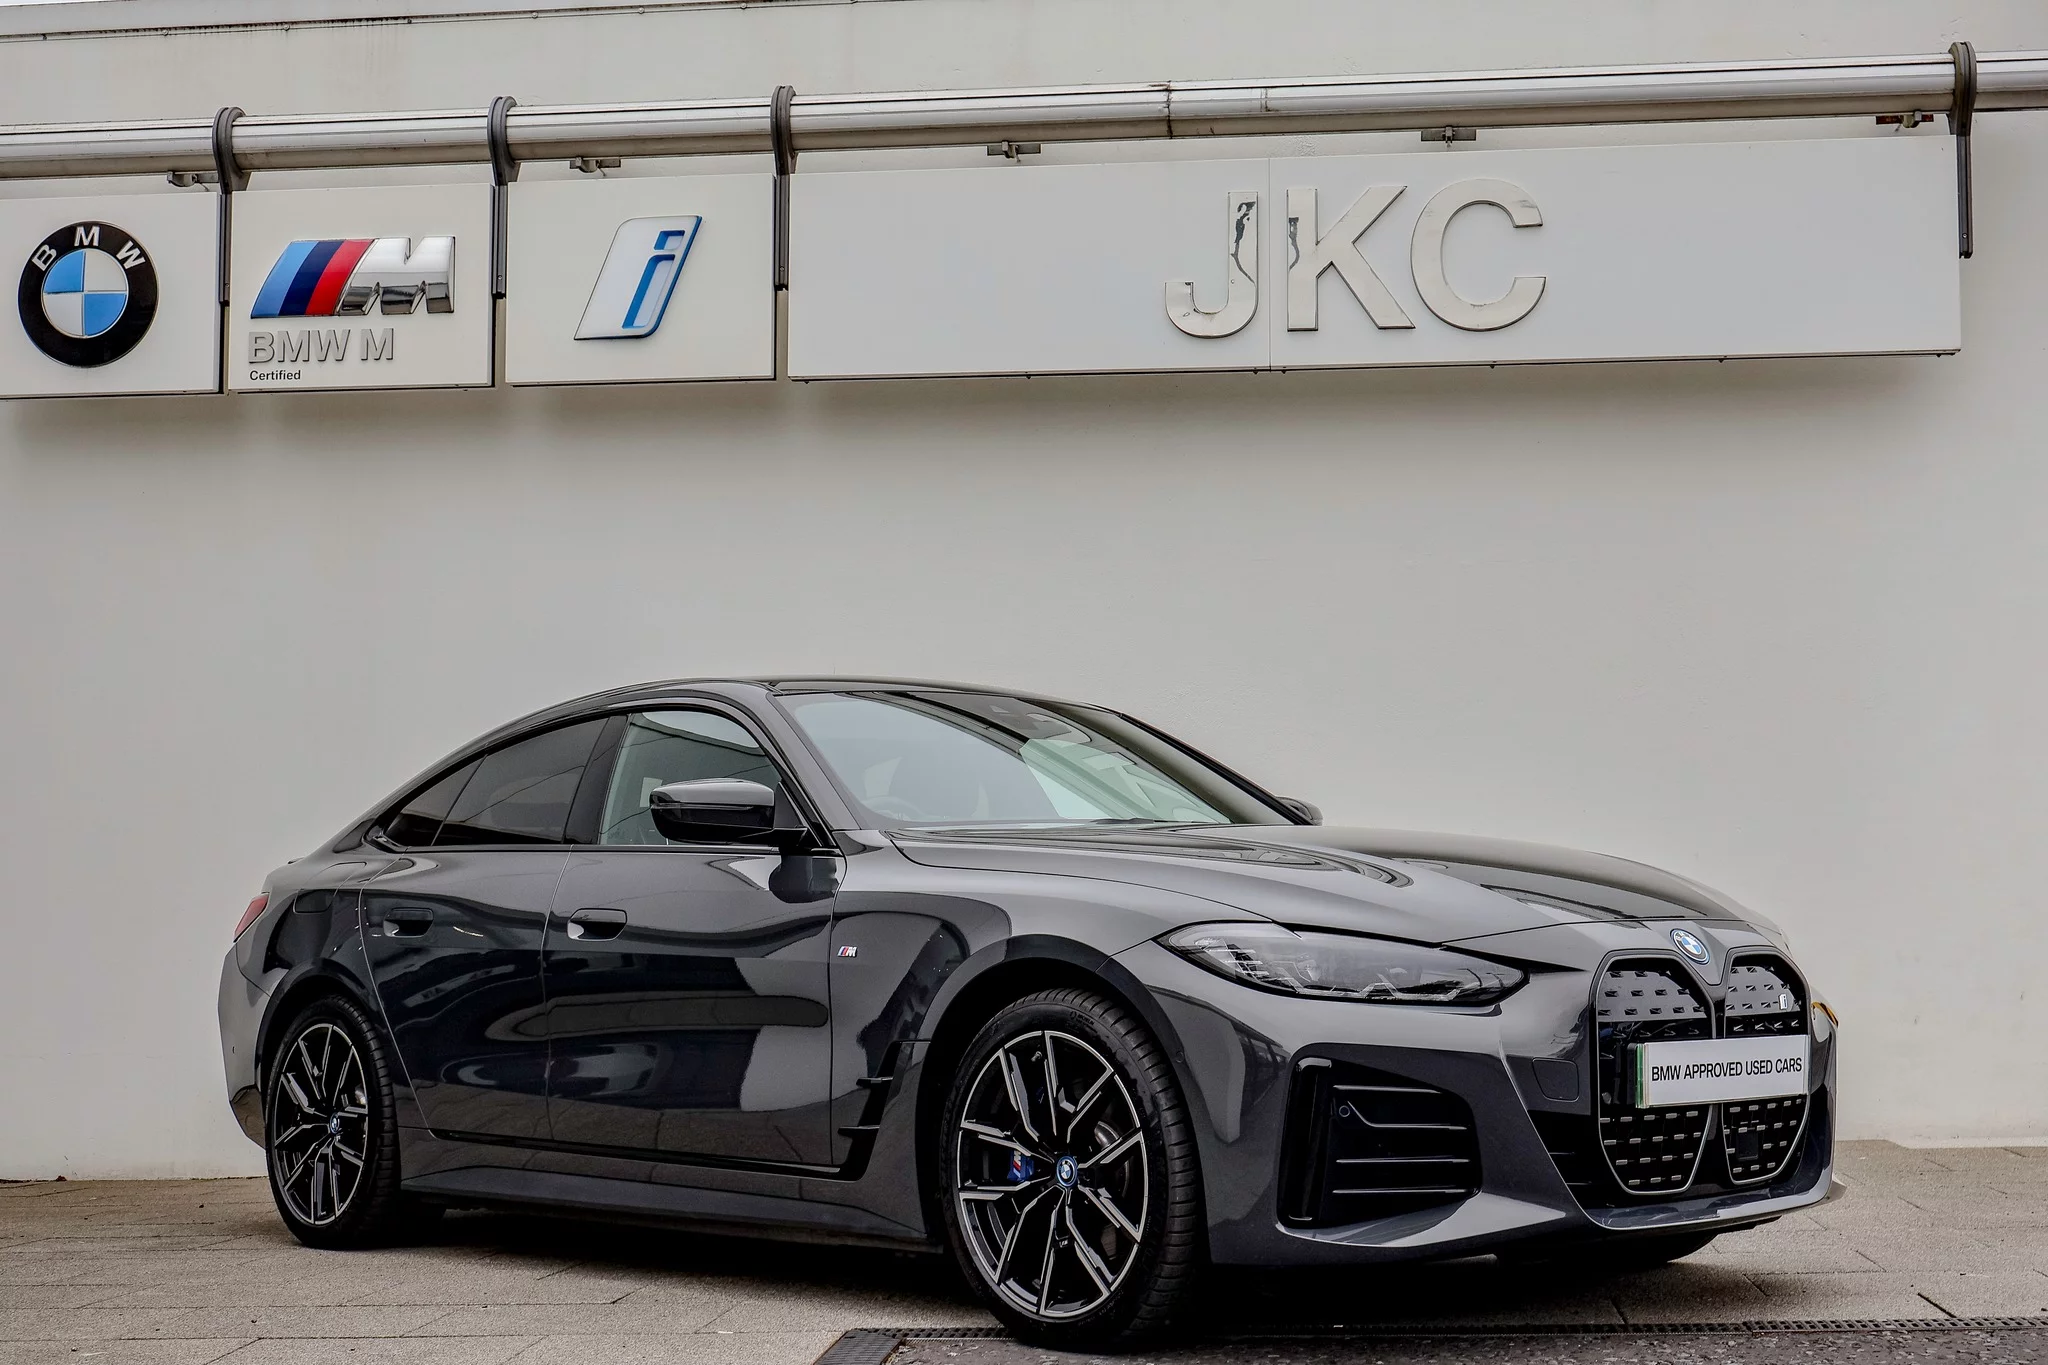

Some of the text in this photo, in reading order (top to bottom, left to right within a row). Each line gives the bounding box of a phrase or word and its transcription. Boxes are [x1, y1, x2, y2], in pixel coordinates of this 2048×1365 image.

[31, 225, 146, 272] BMW
[1164, 178, 1547, 339] JKC
[248, 327, 394, 364] BMW M
[249, 369, 302, 382] Certified
[1651, 1057, 1803, 1082] BMW APPROVED USED CARS
